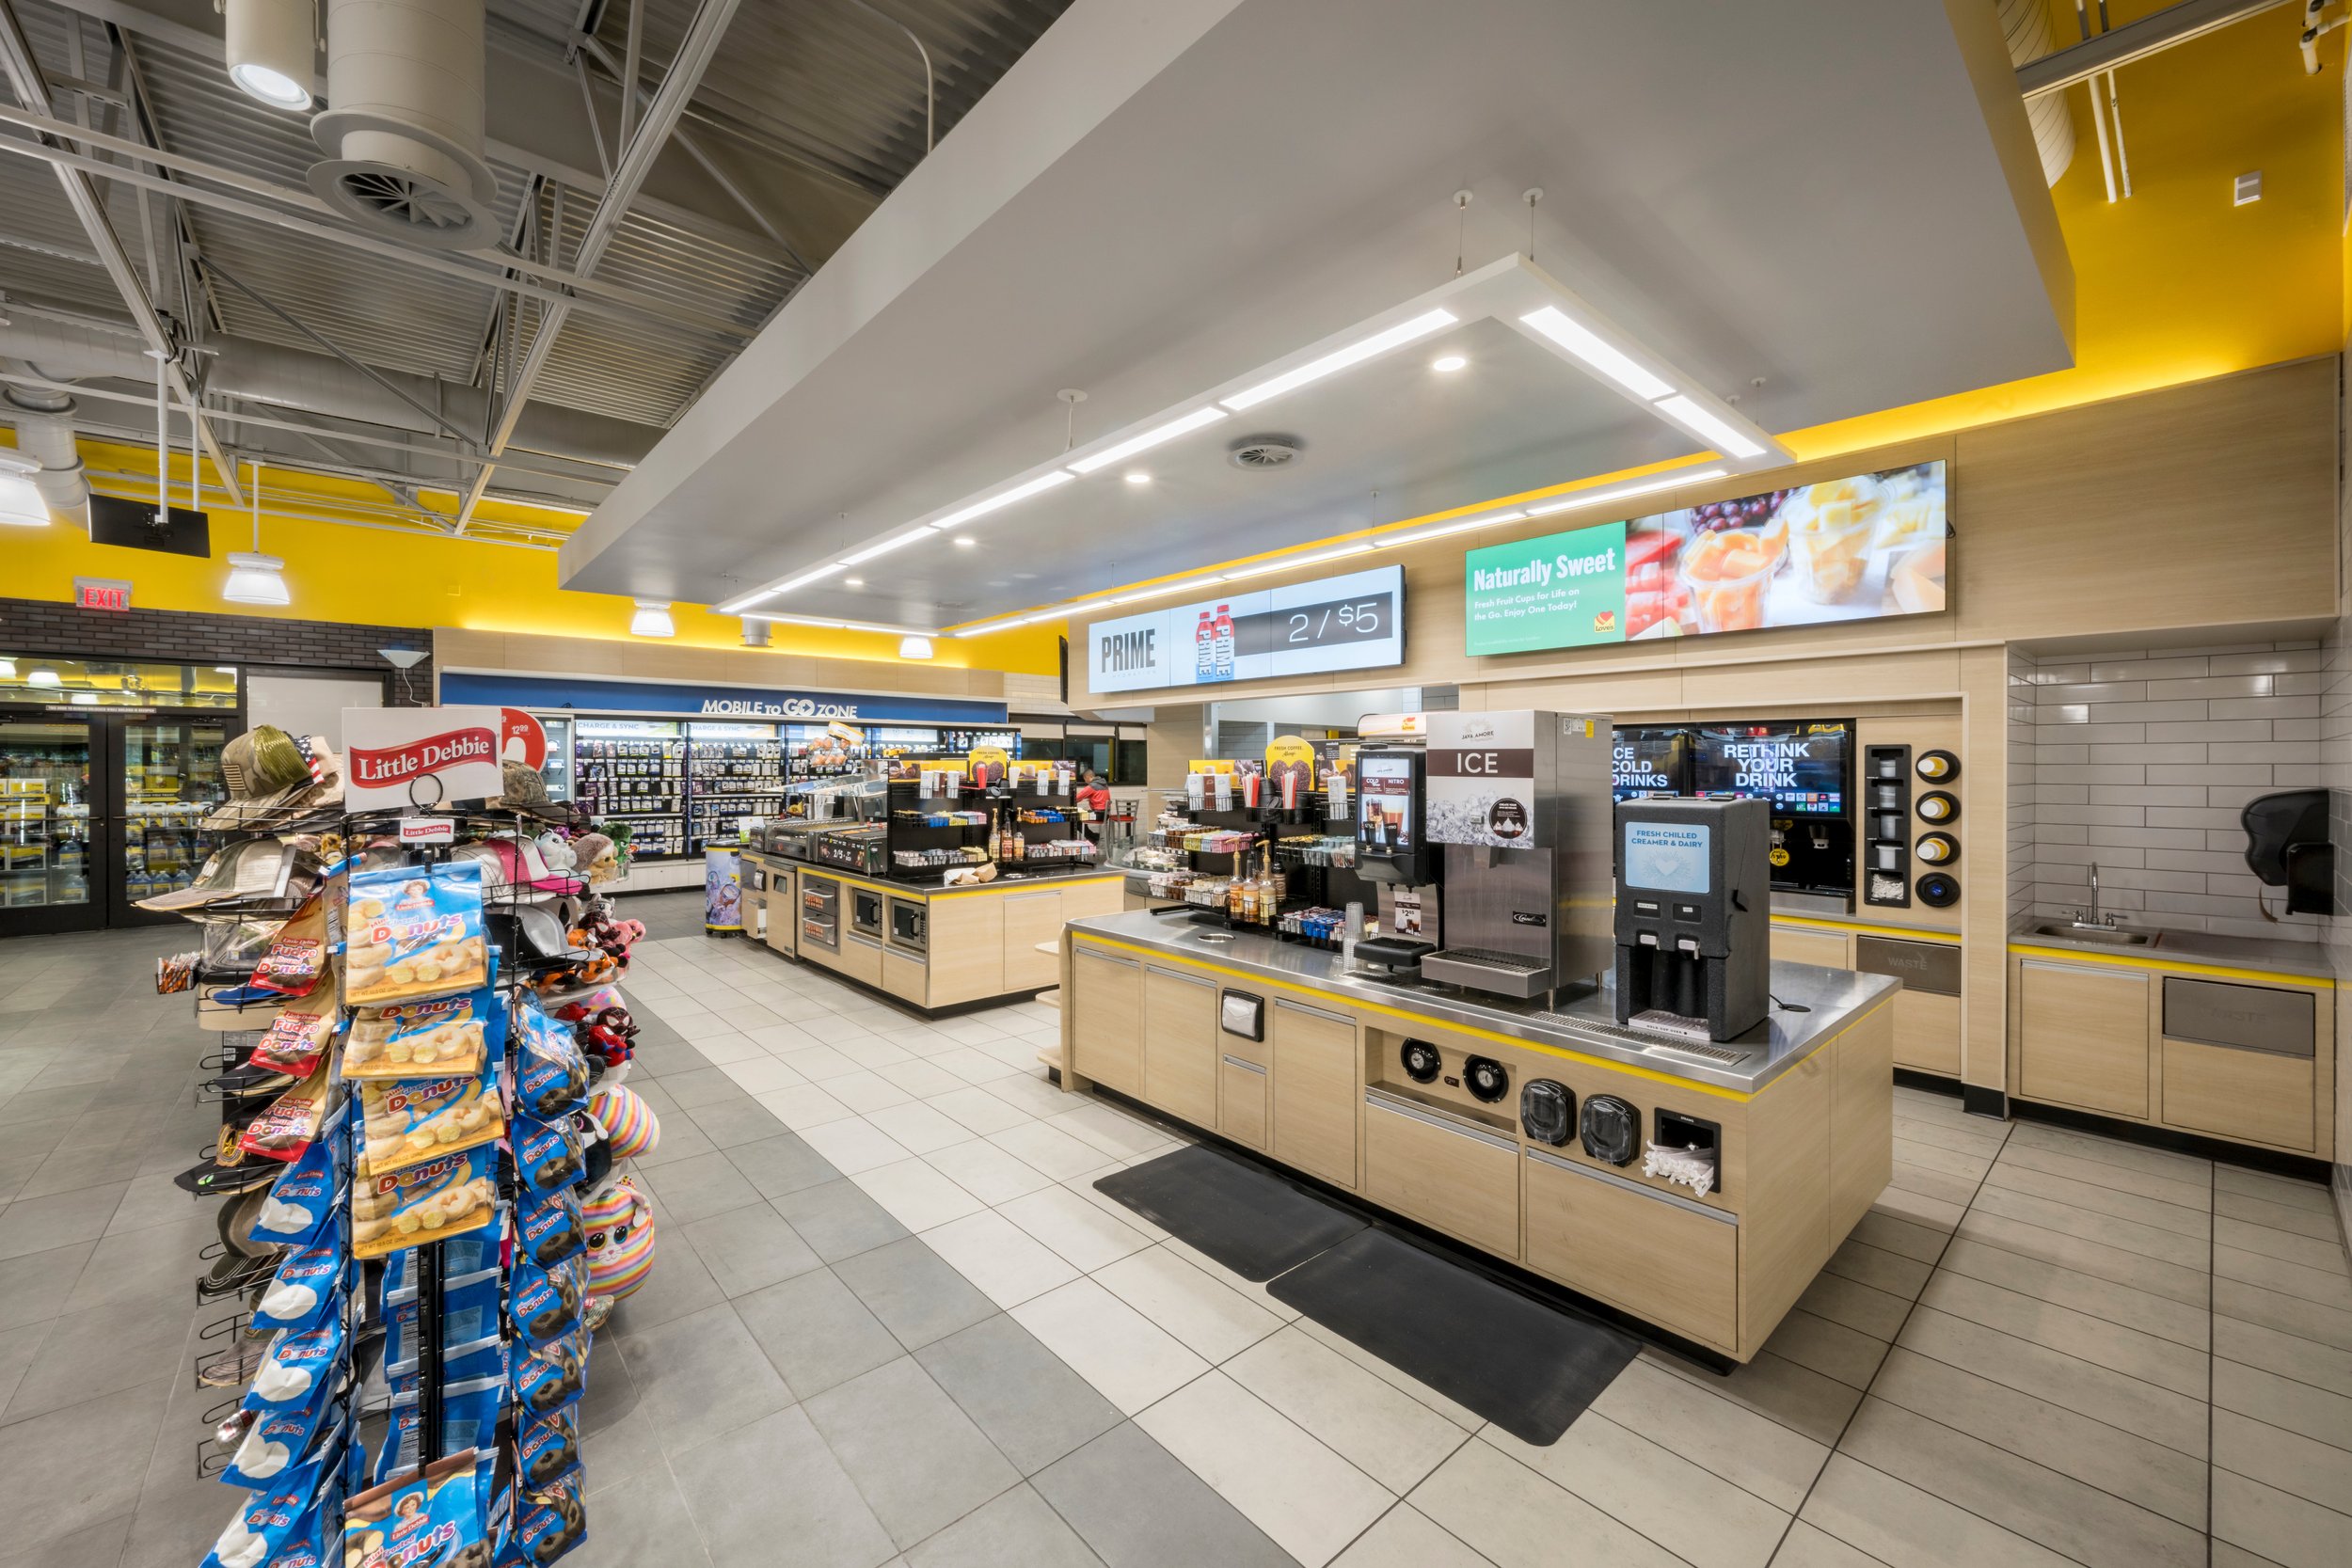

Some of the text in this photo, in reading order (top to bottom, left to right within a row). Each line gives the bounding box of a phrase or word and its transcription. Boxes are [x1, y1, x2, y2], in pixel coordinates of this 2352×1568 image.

[1474, 547, 1616, 592] Naturally Sweet
[85, 588, 125, 609] EXIT
[1474, 598, 1495, 609] Fresh
[1496, 597, 1514, 607] Fruit
[1516, 594, 1535, 606] Cups
[1537, 592, 1549, 601] for
[1551, 589, 1566, 599] Life
[1474, 601, 1577, 621] the Go. Enjoy One Today!
[1102, 628, 1156, 673] PRIME
[1199, 629, 1212, 676] PRIME
[1216, 625, 1232, 677] PRIME
[701, 700, 762, 715] MOBILE
[783, 699, 815, 717] GO
[817, 705, 858, 719] ZONE
[358, 736, 489, 780] Little Debbie
[1724, 743, 1810, 758] RETHINK
[1457, 752, 1498, 774] ICE
[1738, 758, 1794, 773] YOUR
[1736, 773, 1797, 787] DRINK
[424, 825, 449, 834] Debbie
[371, 913, 463, 944] Donuts
[271, 943, 318, 958] Fudge
[257, 962, 315, 974] Donuts
[379, 997, 473, 1020] Donuts
[273, 1019, 319, 1035] Fudge
[258, 1038, 316, 1052] Donuts
[388, 1075, 477, 1115] Donuts
[246, 1122, 309, 1136] Donuts
[526, 1134, 560, 1164] Donuts
[377, 1152, 468, 1195] Donuts
[527, 1210, 564, 1241] Donuts
[516, 1287, 553, 1317] Donuts
[408, 1516, 429, 1531] Debbie
[523, 1512, 556, 1544] Donuts
[365, 1534, 415, 1567] Mini Frosted
